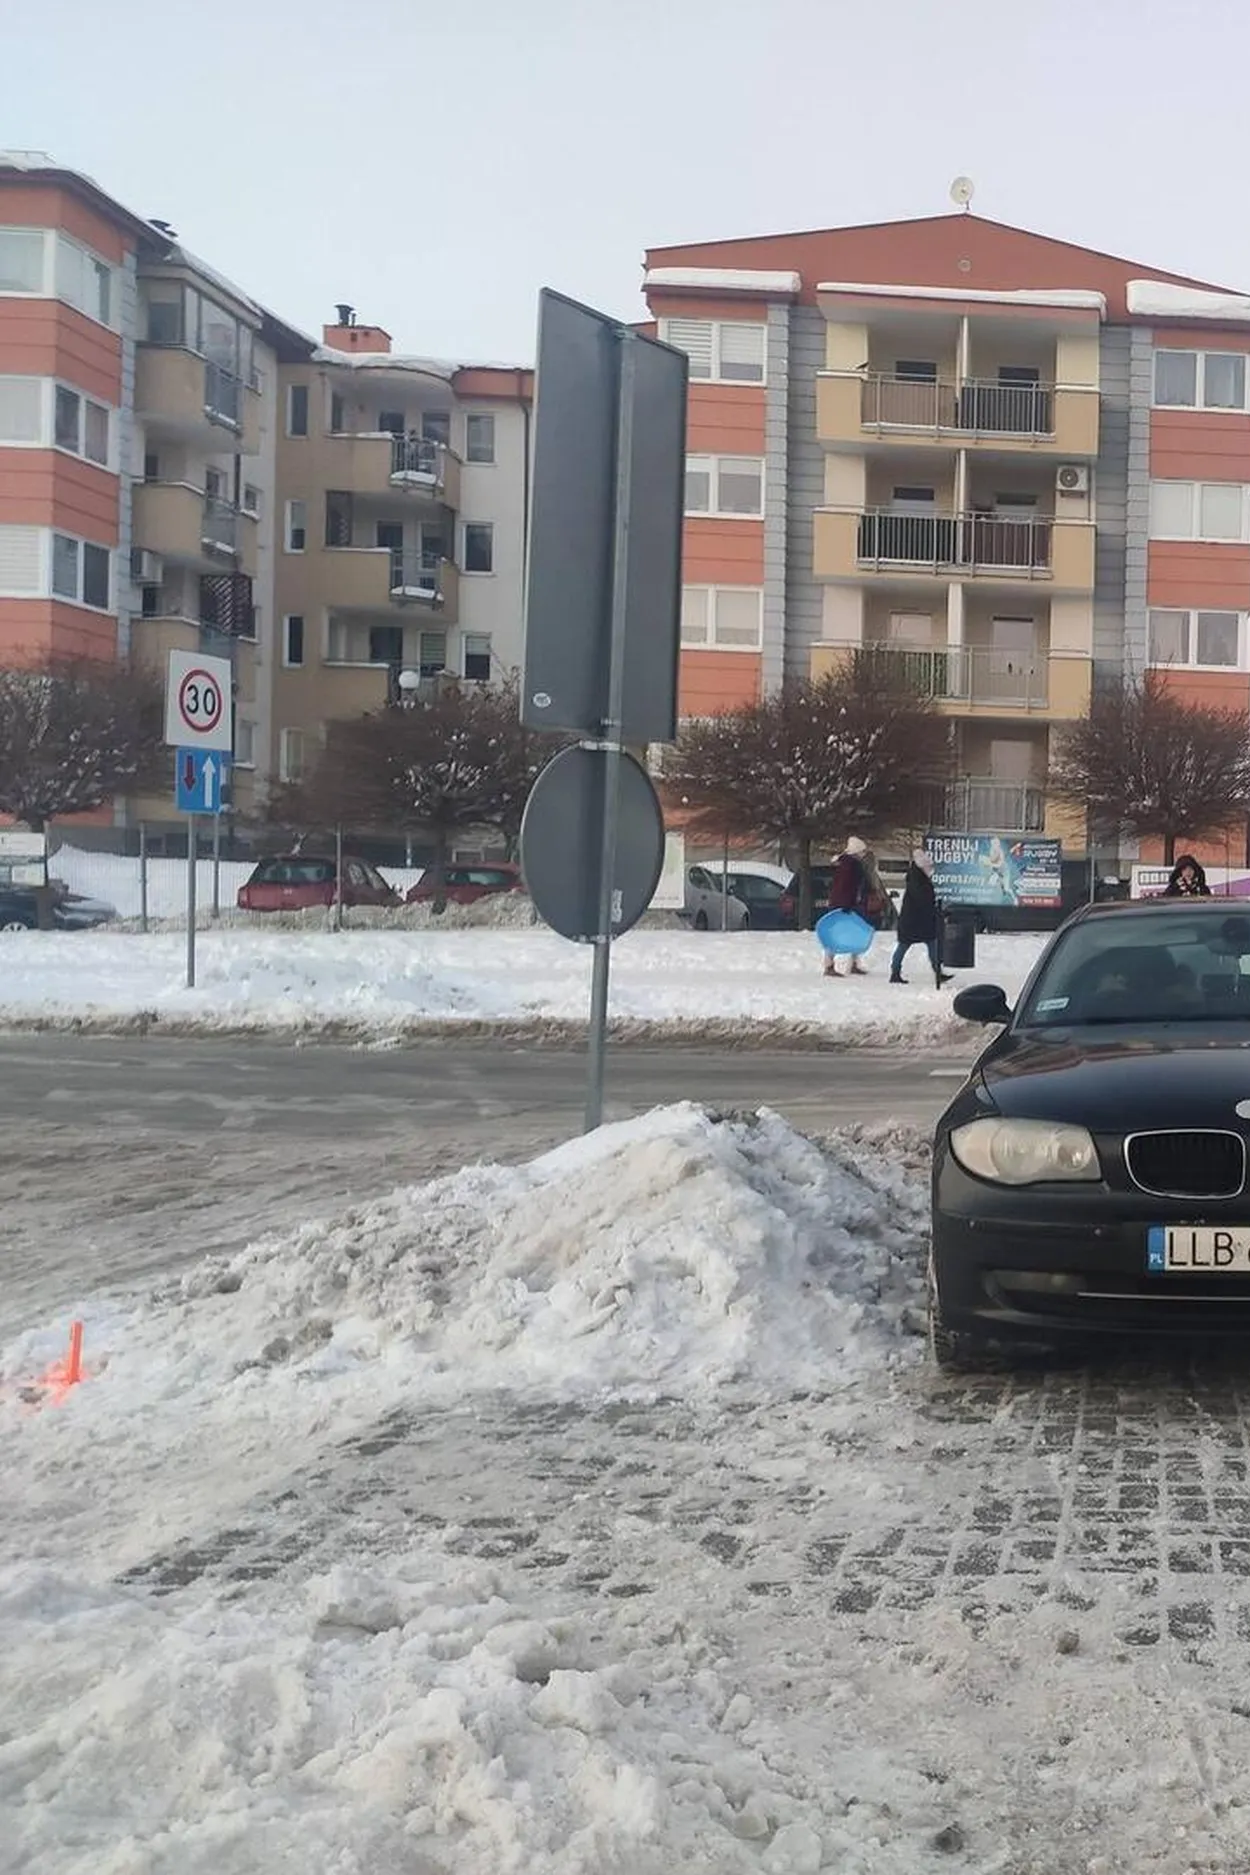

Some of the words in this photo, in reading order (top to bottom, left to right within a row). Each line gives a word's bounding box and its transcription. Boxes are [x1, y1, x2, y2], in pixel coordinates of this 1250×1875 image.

[186, 684, 216, 717] 30
[926, 838, 979, 851] TRENUJ
[1150, 1253, 1163, 1264] PL
[1168, 1231, 1235, 1267] LLB
